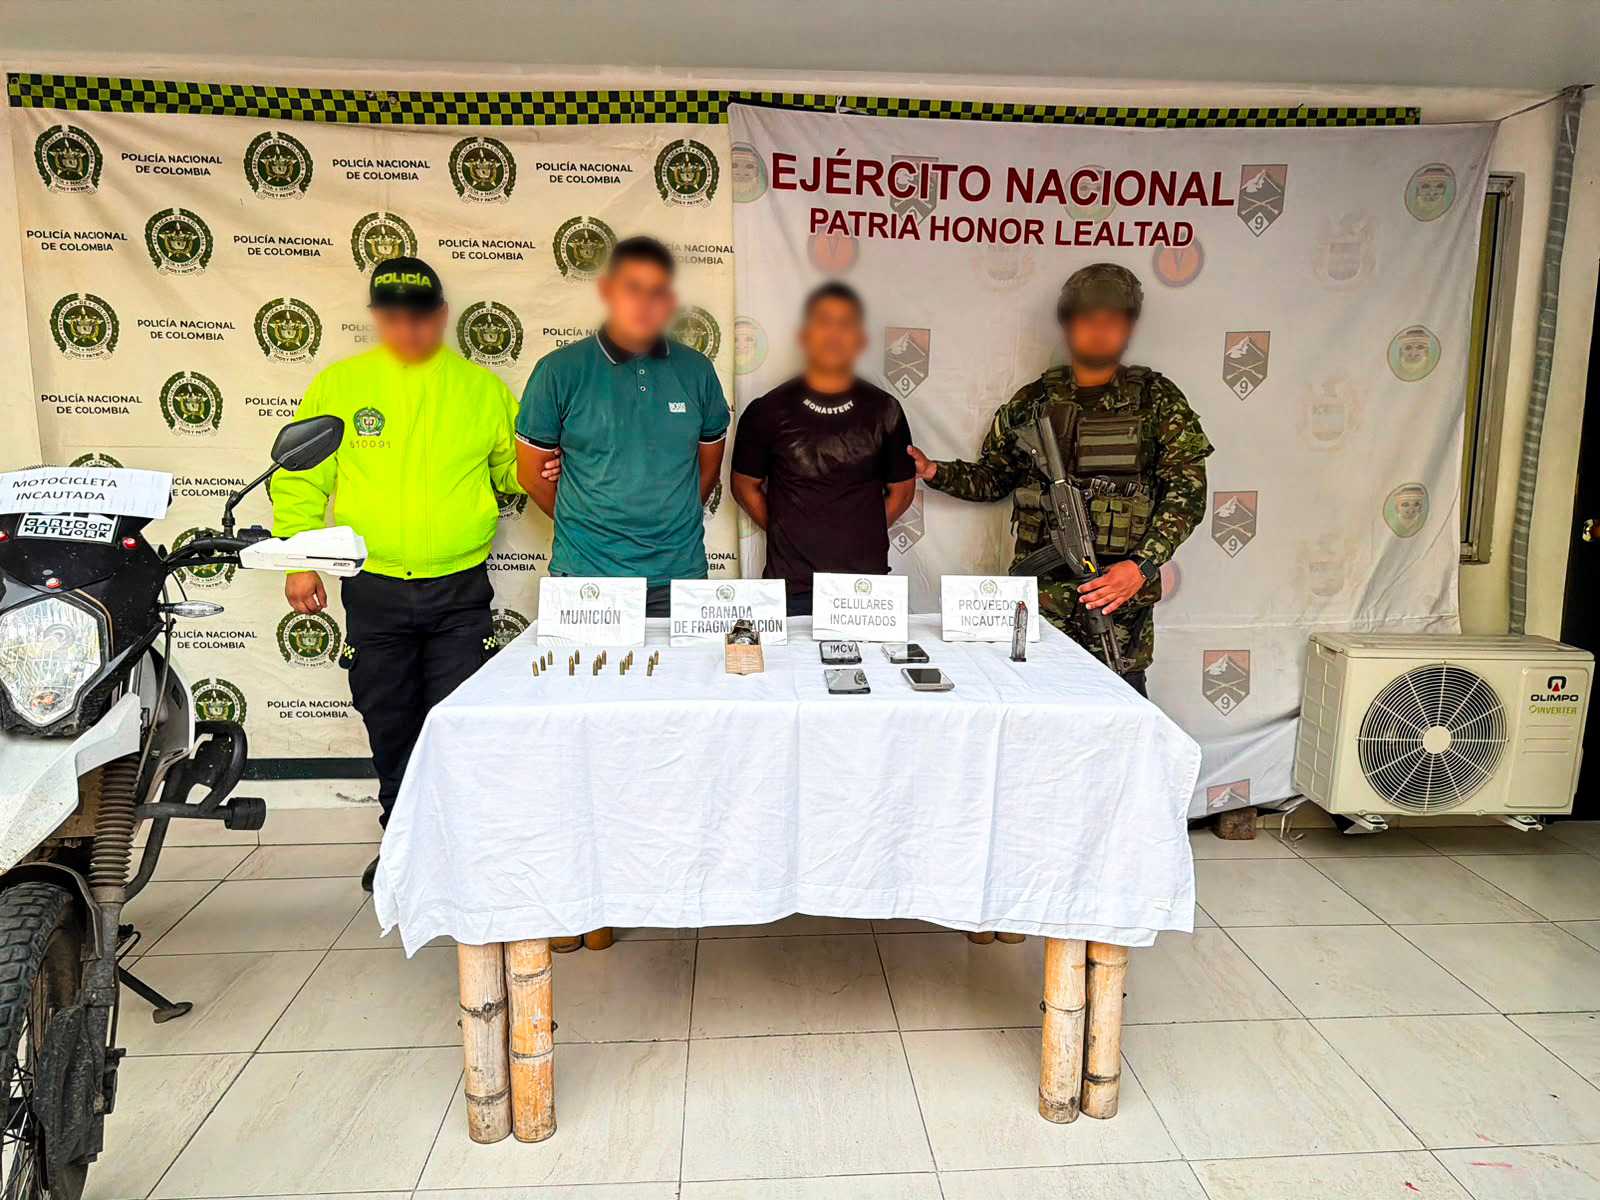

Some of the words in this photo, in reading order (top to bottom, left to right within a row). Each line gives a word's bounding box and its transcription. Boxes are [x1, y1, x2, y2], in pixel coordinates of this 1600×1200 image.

[122, 152, 166, 162] POLICÍA
[168, 155, 222, 164] NACIONAL
[333, 158, 374, 167] POLICÍA
[377, 160, 430, 168] NACIONAL
[136, 165, 150, 173] DE
[153, 166, 210, 175] COLOMBIA
[536, 161, 577, 171] POLICÍA
[580, 164, 632, 172] NACIONAL
[363, 172, 419, 180] COLOMBIA
[550, 175, 563, 183] DE
[566, 175, 620, 183] COLOMBIA
[771, 148, 992, 202] EJÉRCITO
[1006, 167, 1234, 207] NACIONAL
[810, 208, 920, 241] PATRIA
[929, 215, 1044, 245] HONOR
[1055, 220, 1193, 247] LEALTAD
[27, 229, 71, 239] POLICÍA
[74, 232, 128, 240] NACIONAL
[234, 235, 275, 243] POLICÍA
[279, 237, 333, 245] NACIONAL
[439, 239, 479, 247] POLICÍA
[482, 240, 536, 248] NACIONAL
[60, 243, 113, 251] COLOMBIA
[264, 248, 320, 256] COLOMBIA
[684, 244, 735, 253] NACIONAL
[452, 251, 465, 259] DE
[469, 252, 523, 260] COLOMBIA
[375, 273, 432, 288] POLICÍA
[138, 319, 177, 327] POLICÍA
[180, 321, 235, 329] NACIONAL
[150, 331, 163, 339] DE
[167, 332, 224, 340] COLOMBIA
[1240, 380, 1250, 395] 9
[41, 394, 85, 402] POLICÍA
[245, 396, 288, 406] POLICÍA
[803, 399, 854, 414] MONASTERY
[12, 477, 118, 488] MOTOCICLETA
[195, 478, 247, 486] NACIONAL
[16, 491, 105, 500] INCAUTADA
[24, 518, 112, 531] CARTOON
[1228, 538, 1237, 551] 9
[833, 598, 894, 610] CELULARES
[959, 600, 1017, 610] PROVEEDO
[560, 607, 621, 625] MUNICIÓN
[701, 606, 753, 619] GRANADA
[830, 614, 896, 627] INCAUTADOS
[961, 616, 1014, 626] INCAUTAD
[674, 621, 688, 633] DE
[171, 630, 203, 638] OLICÍA
[193, 641, 245, 649] COLOMBIA
[1221, 696, 1230, 709] 9
[1531, 694, 1579, 702] OLIMPO
[267, 699, 306, 708] POLICÍA
[309, 700, 353, 708] NACIONA
[1537, 706, 1577, 714] INVERTER
